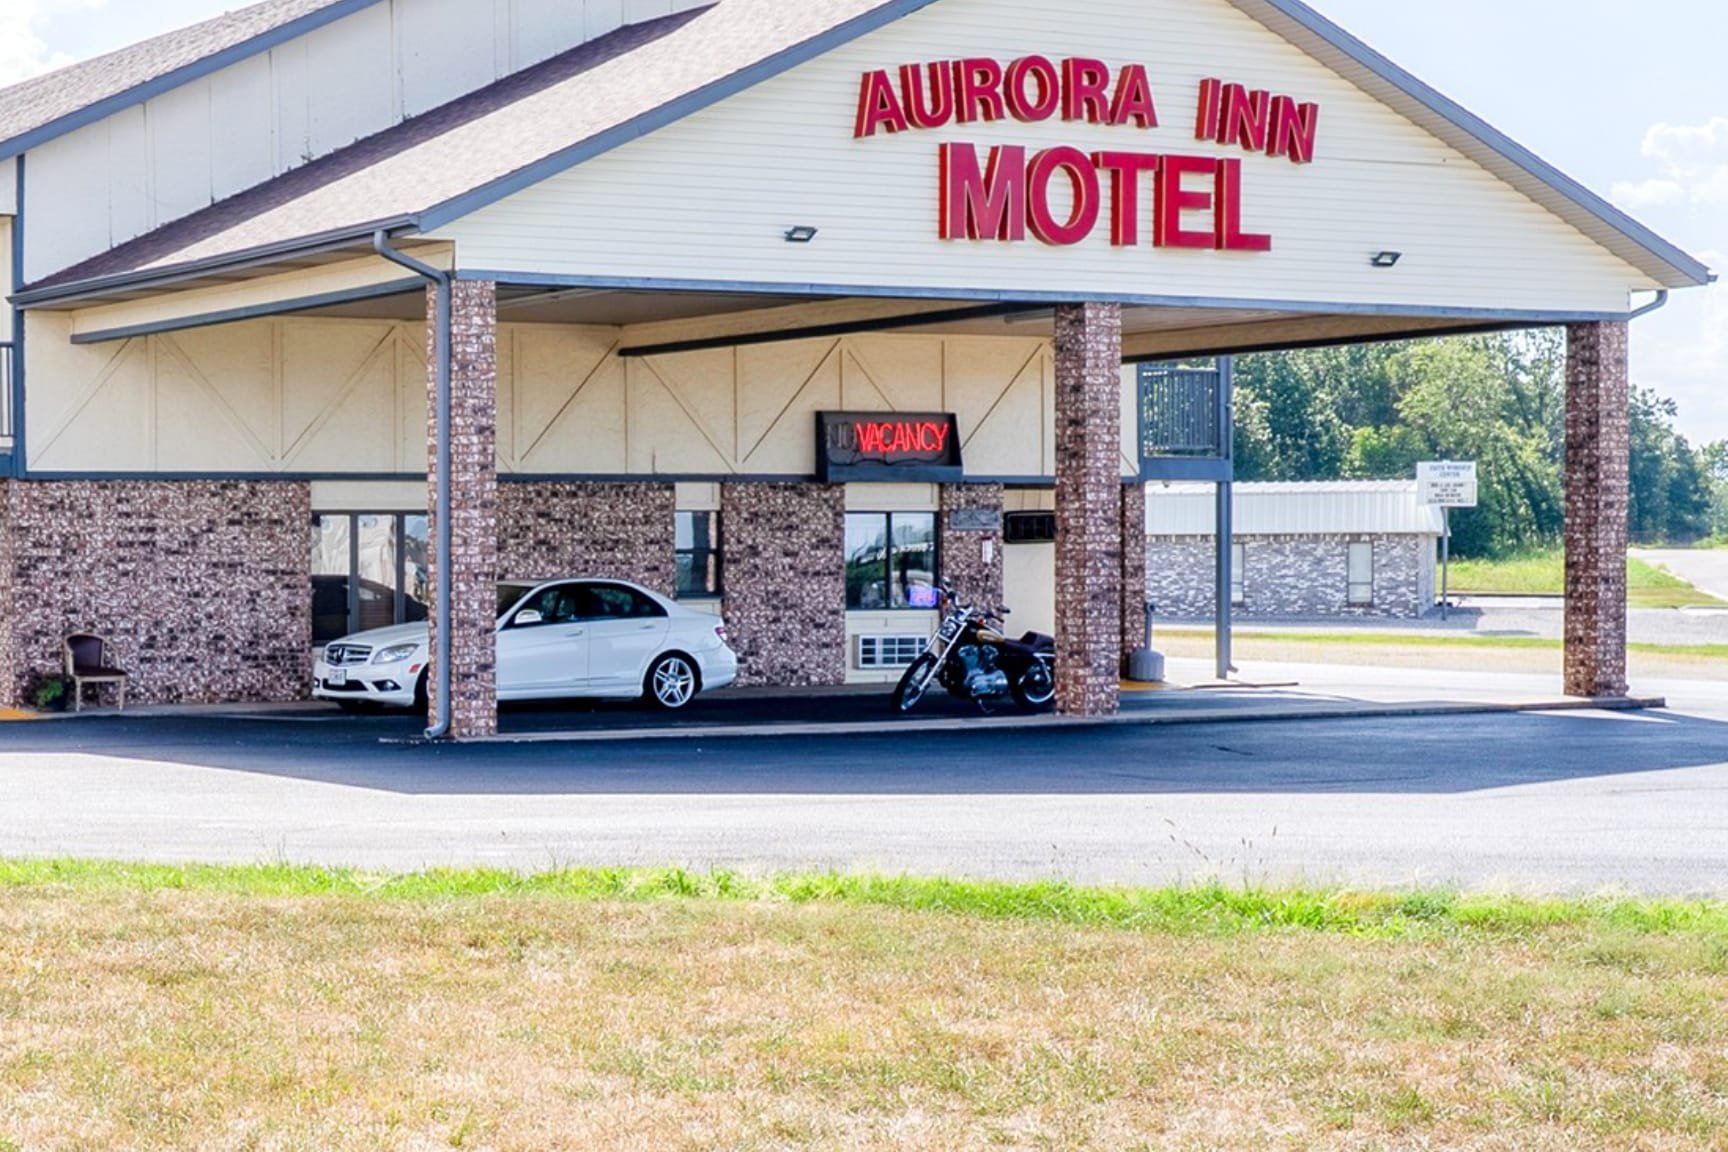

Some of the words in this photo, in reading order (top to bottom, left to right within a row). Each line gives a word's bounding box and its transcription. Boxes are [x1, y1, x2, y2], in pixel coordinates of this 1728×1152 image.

[853, 54, 1159, 139] AURORA
[1194, 76, 1320, 164] INN
[938, 142, 1272, 252] MOTEL
[855, 421, 949, 452] VACANCY
